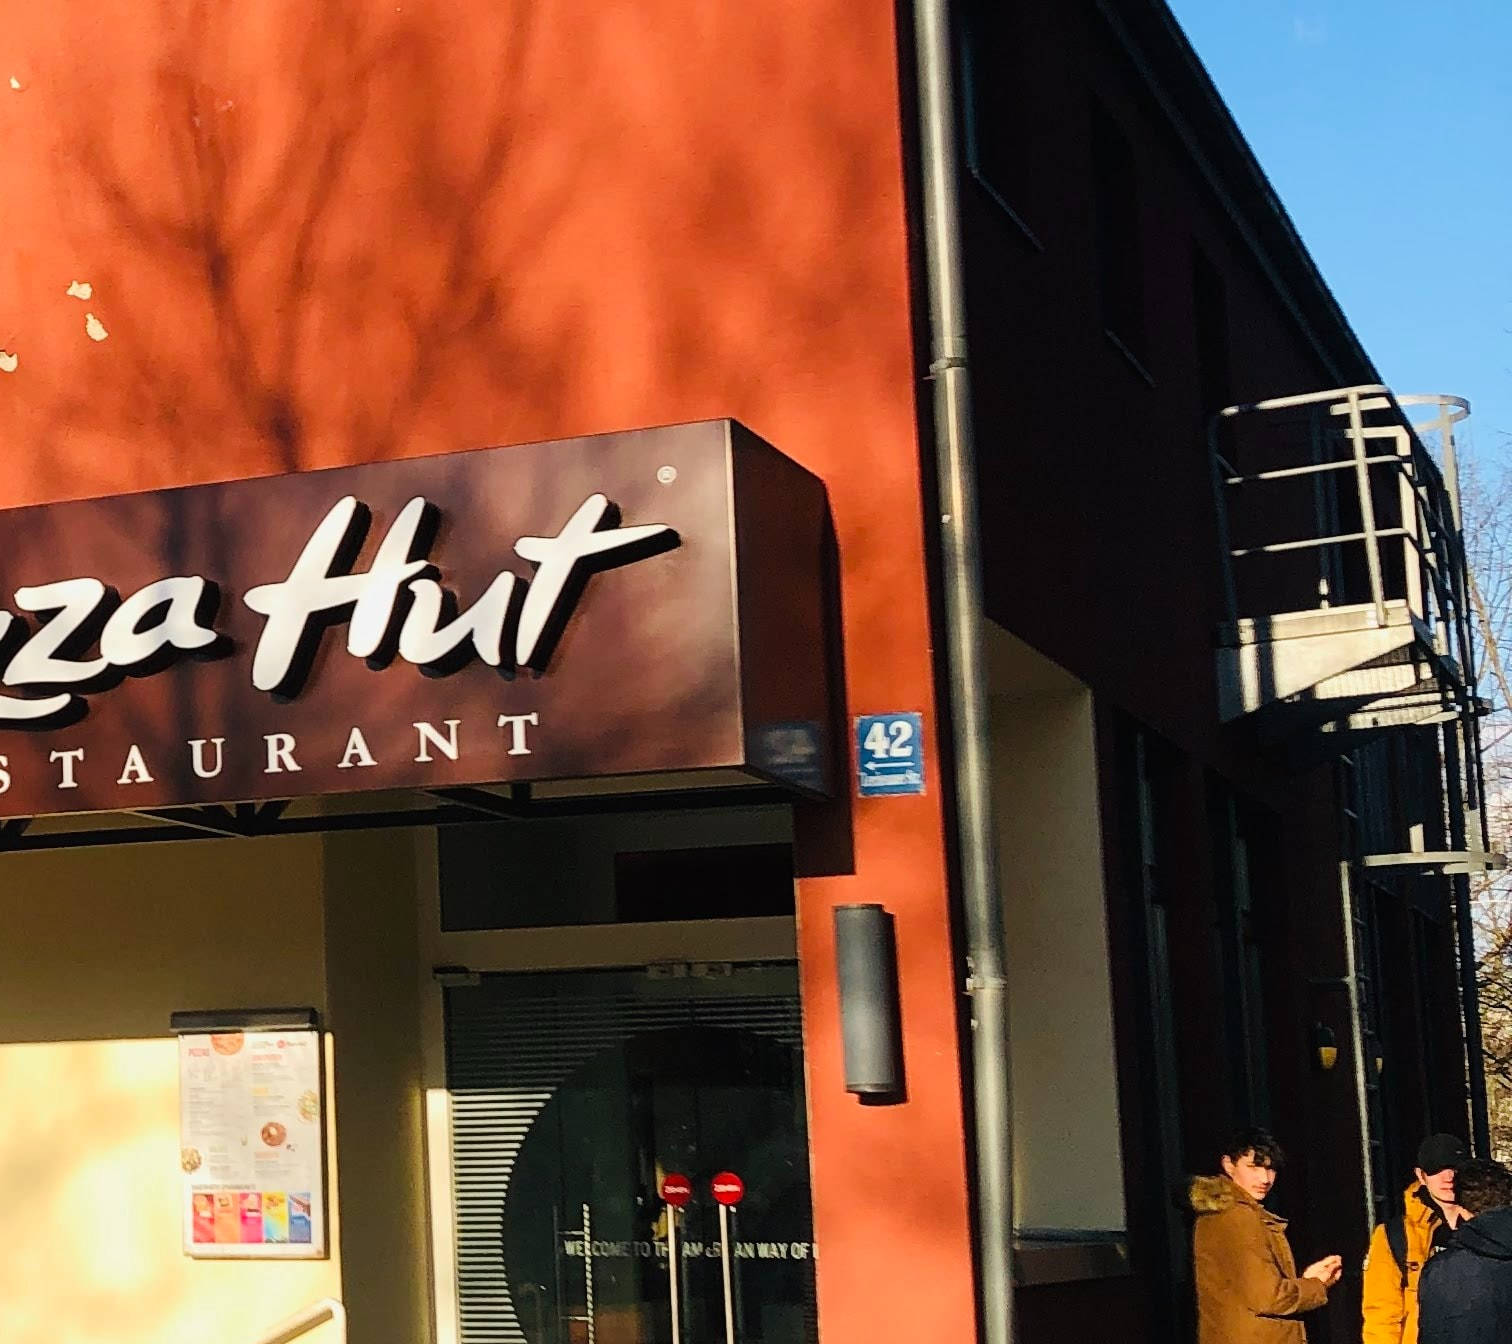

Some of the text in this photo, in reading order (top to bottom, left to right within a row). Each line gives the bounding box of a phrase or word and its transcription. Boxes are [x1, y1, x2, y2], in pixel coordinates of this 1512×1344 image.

[244, 494, 674, 691] Hut
[864, 721, 913, 758] 42
[564, 1240, 629, 1257] WECOME
[756, 1242, 787, 1259] WAY
[790, 1242, 810, 1259] OF
